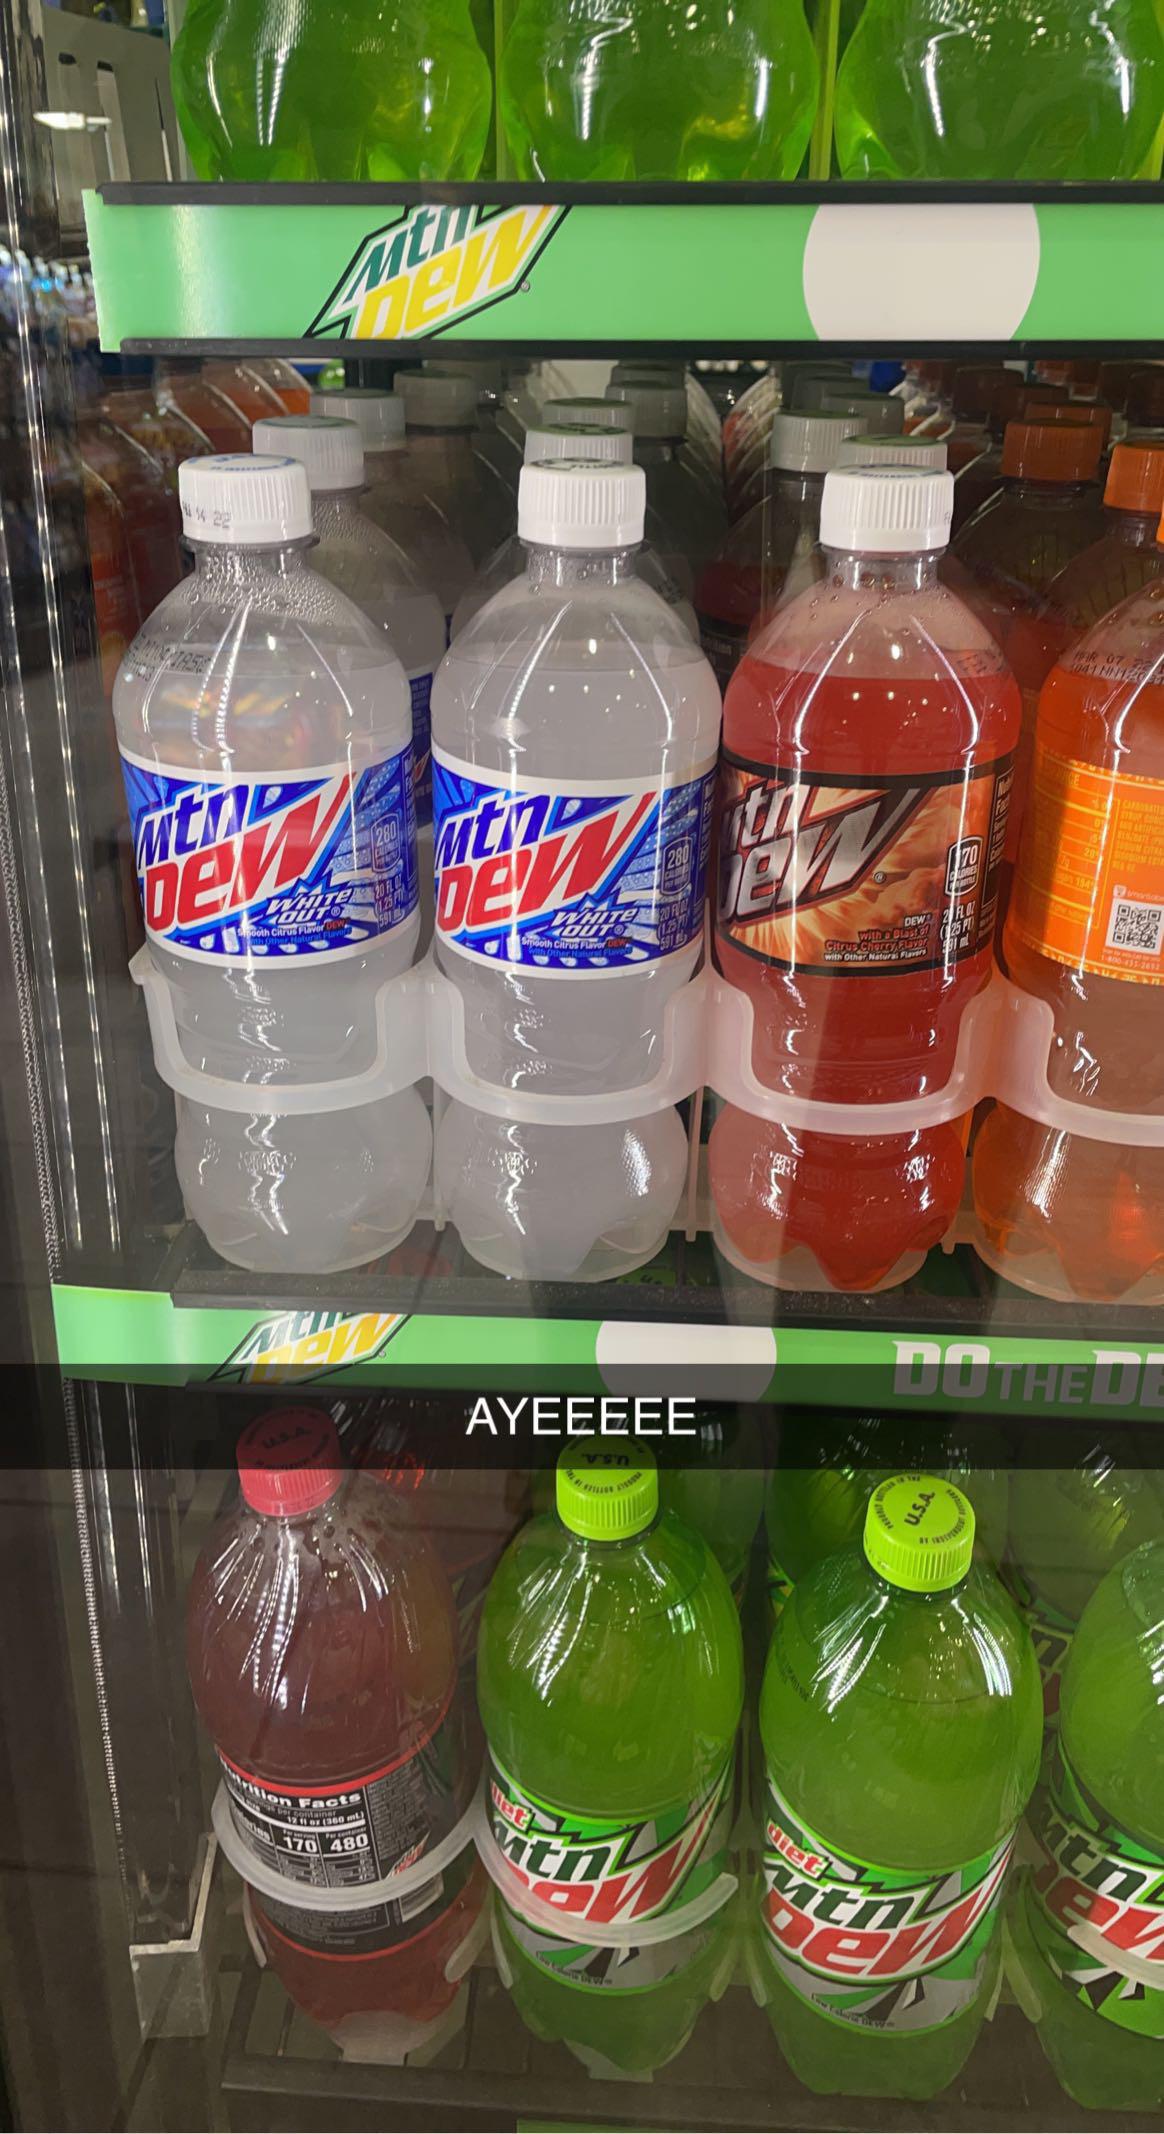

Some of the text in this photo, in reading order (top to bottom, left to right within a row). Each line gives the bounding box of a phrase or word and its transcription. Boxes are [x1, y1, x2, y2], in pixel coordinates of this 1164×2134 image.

[345, 205, 474, 300] Mtn
[213, 510, 232, 529] 22
[138, 784, 250, 871] Mtn
[375, 821, 397, 846] 280
[436, 795, 550, 871] Mtn
[667, 845, 689, 870] 280
[956, 844, 978, 867] 70
[266, 888, 352, 915] WHITE
[956, 904, 965, 919] FL
[966, 900, 976, 916] OZ
[277, 906, 331, 925] OUT
[551, 908, 638, 927] WHITE
[660, 906, 670, 922] 20
[904, 914, 926, 927] DEW
[271, 926, 297, 937] Citrus
[299, 924, 325, 935] Flavor
[561, 924, 615, 936] OUT
[859, 930, 882, 940] with
[893, 928, 918, 938] Blast
[919, 926, 929, 935] of
[521, 937, 552, 949] Smooth
[553, 940, 579, 949] Citrus
[581, 940, 605, 949] Flavor
[660, 936, 674, 951] 591
[825, 938, 927, 952] Citrus Cherry Flavor
[825, 952, 842, 960] with
[844, 952, 867, 960] Other
[900, 949, 927, 958] Flavors
[892, 1340, 991, 1398] DO
[994, 1361, 1089, 1404] THE
[298, 1793, 361, 1809] Facts
[287, 1816, 298, 1825] 12
[322, 1815, 345, 1827] (360
[294, 1810, 336, 1818] container
[283, 1836, 318, 1853] 170
[330, 1833, 369, 1852] 480
[767, 1822, 824, 1876] diet
